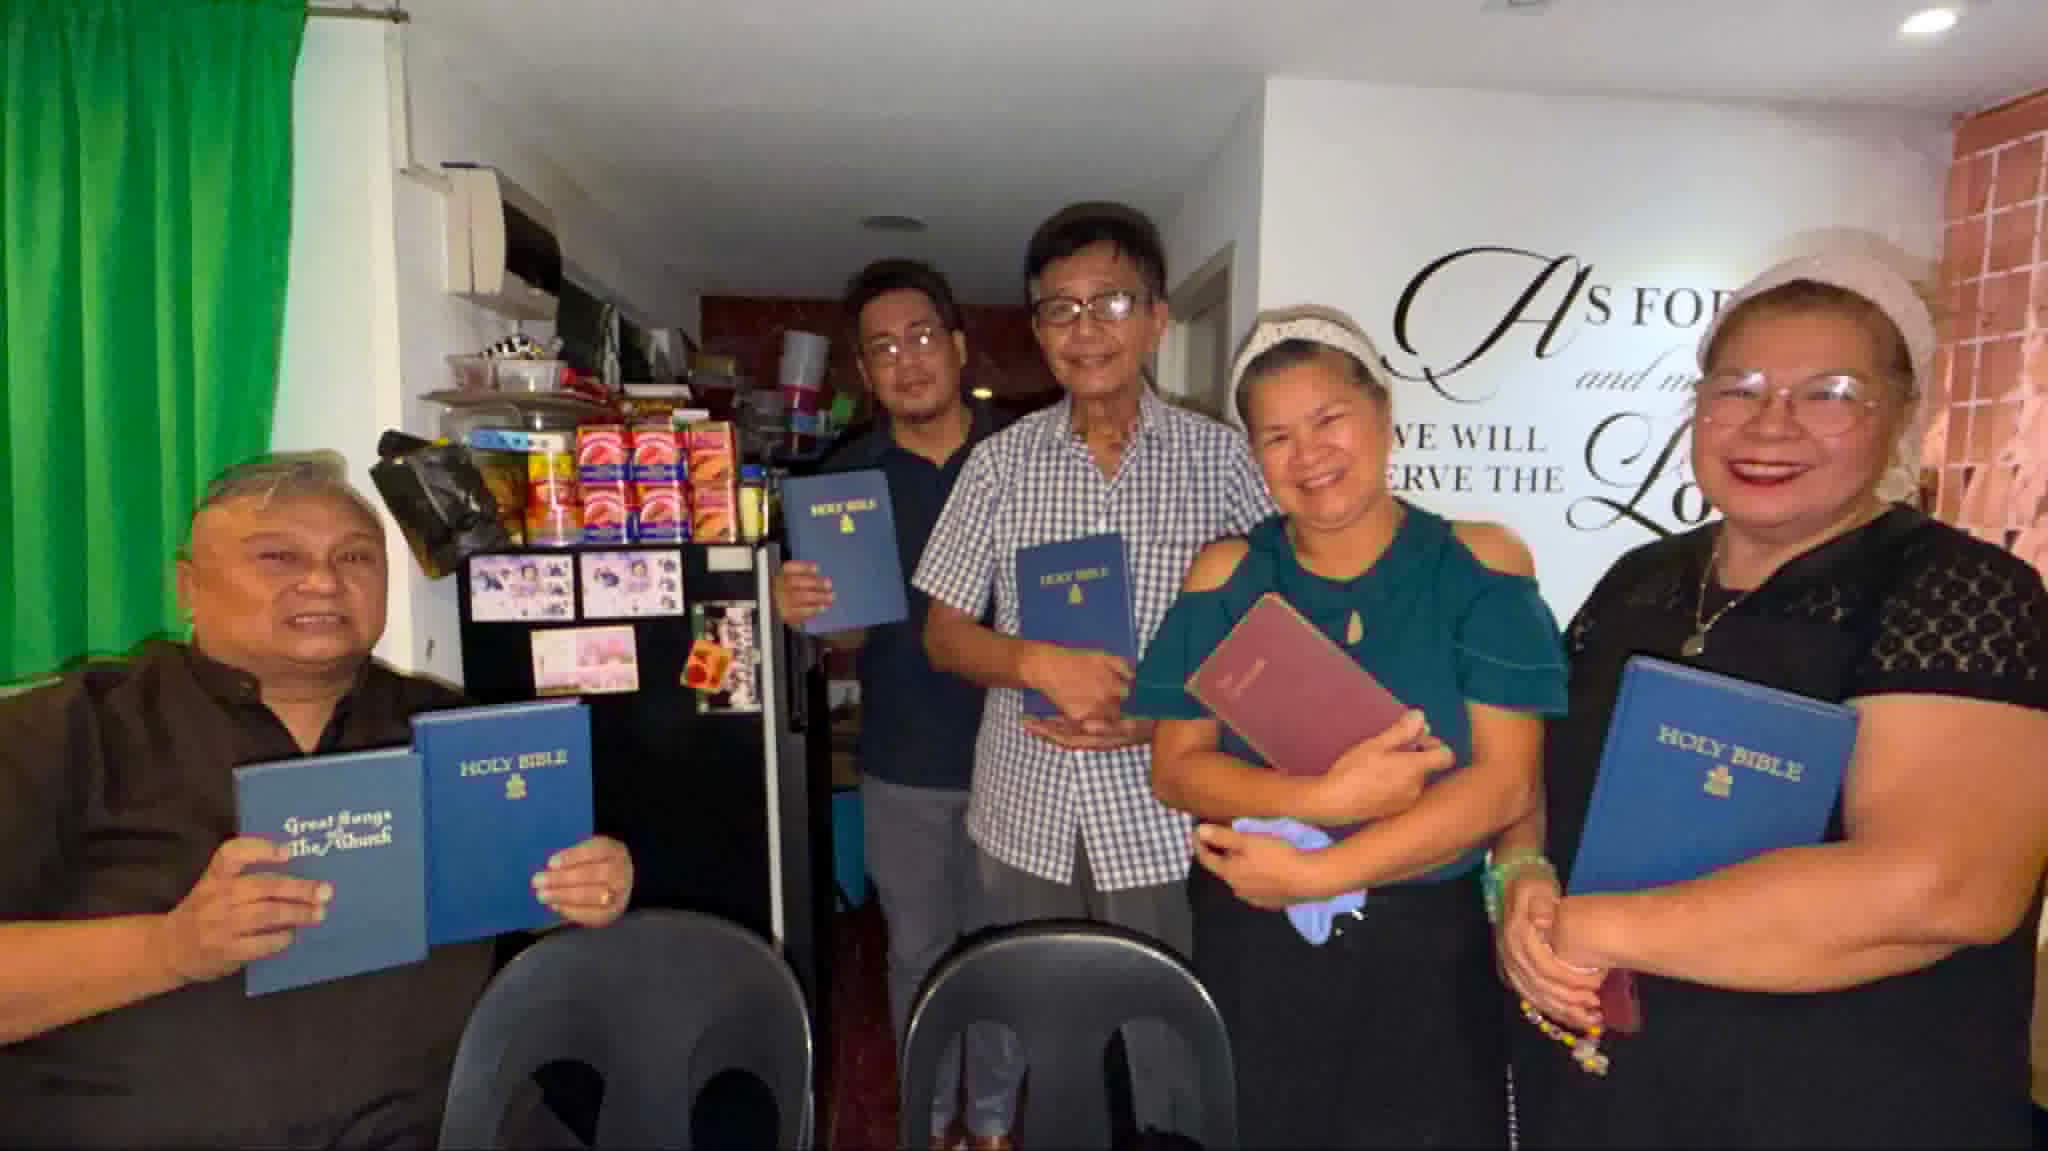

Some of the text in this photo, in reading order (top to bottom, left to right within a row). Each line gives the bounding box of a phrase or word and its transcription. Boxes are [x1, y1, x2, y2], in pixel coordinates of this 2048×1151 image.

[1379, 246, 1611, 403] AS
[1575, 345, 1688, 392] and
[1450, 423, 1548, 452] WILL
[1484, 464, 1565, 494] THE
[459, 748, 568, 777] HOLY BIBLE
[1655, 724, 1806, 783] HOLY BIBLE
[283, 815, 334, 838] Great
